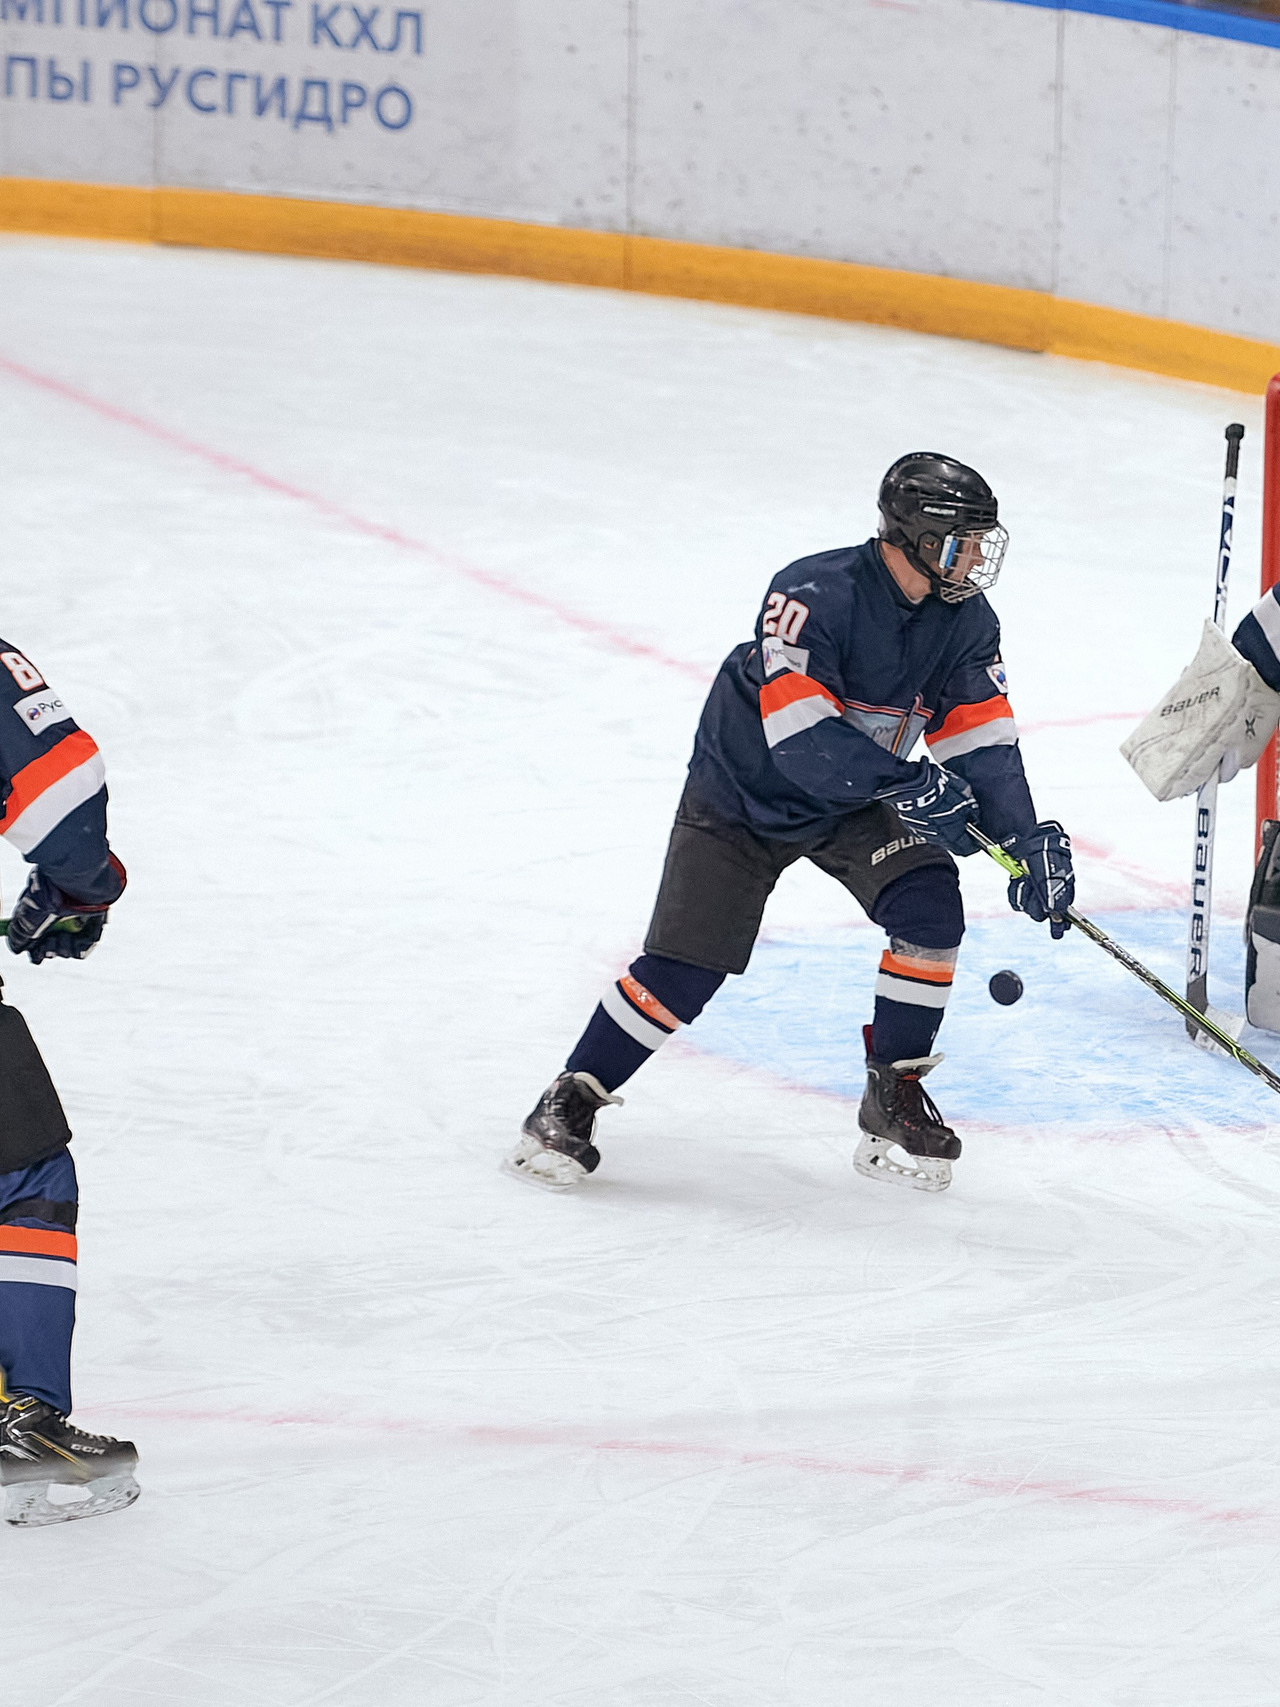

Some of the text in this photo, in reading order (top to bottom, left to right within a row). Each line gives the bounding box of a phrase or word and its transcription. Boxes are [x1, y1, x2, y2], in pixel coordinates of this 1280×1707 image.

[311, 3, 423, 55] КХЛ
[5, 56, 413, 132] ПЫ РУСГИДРО
[762, 591, 810, 645] 20
